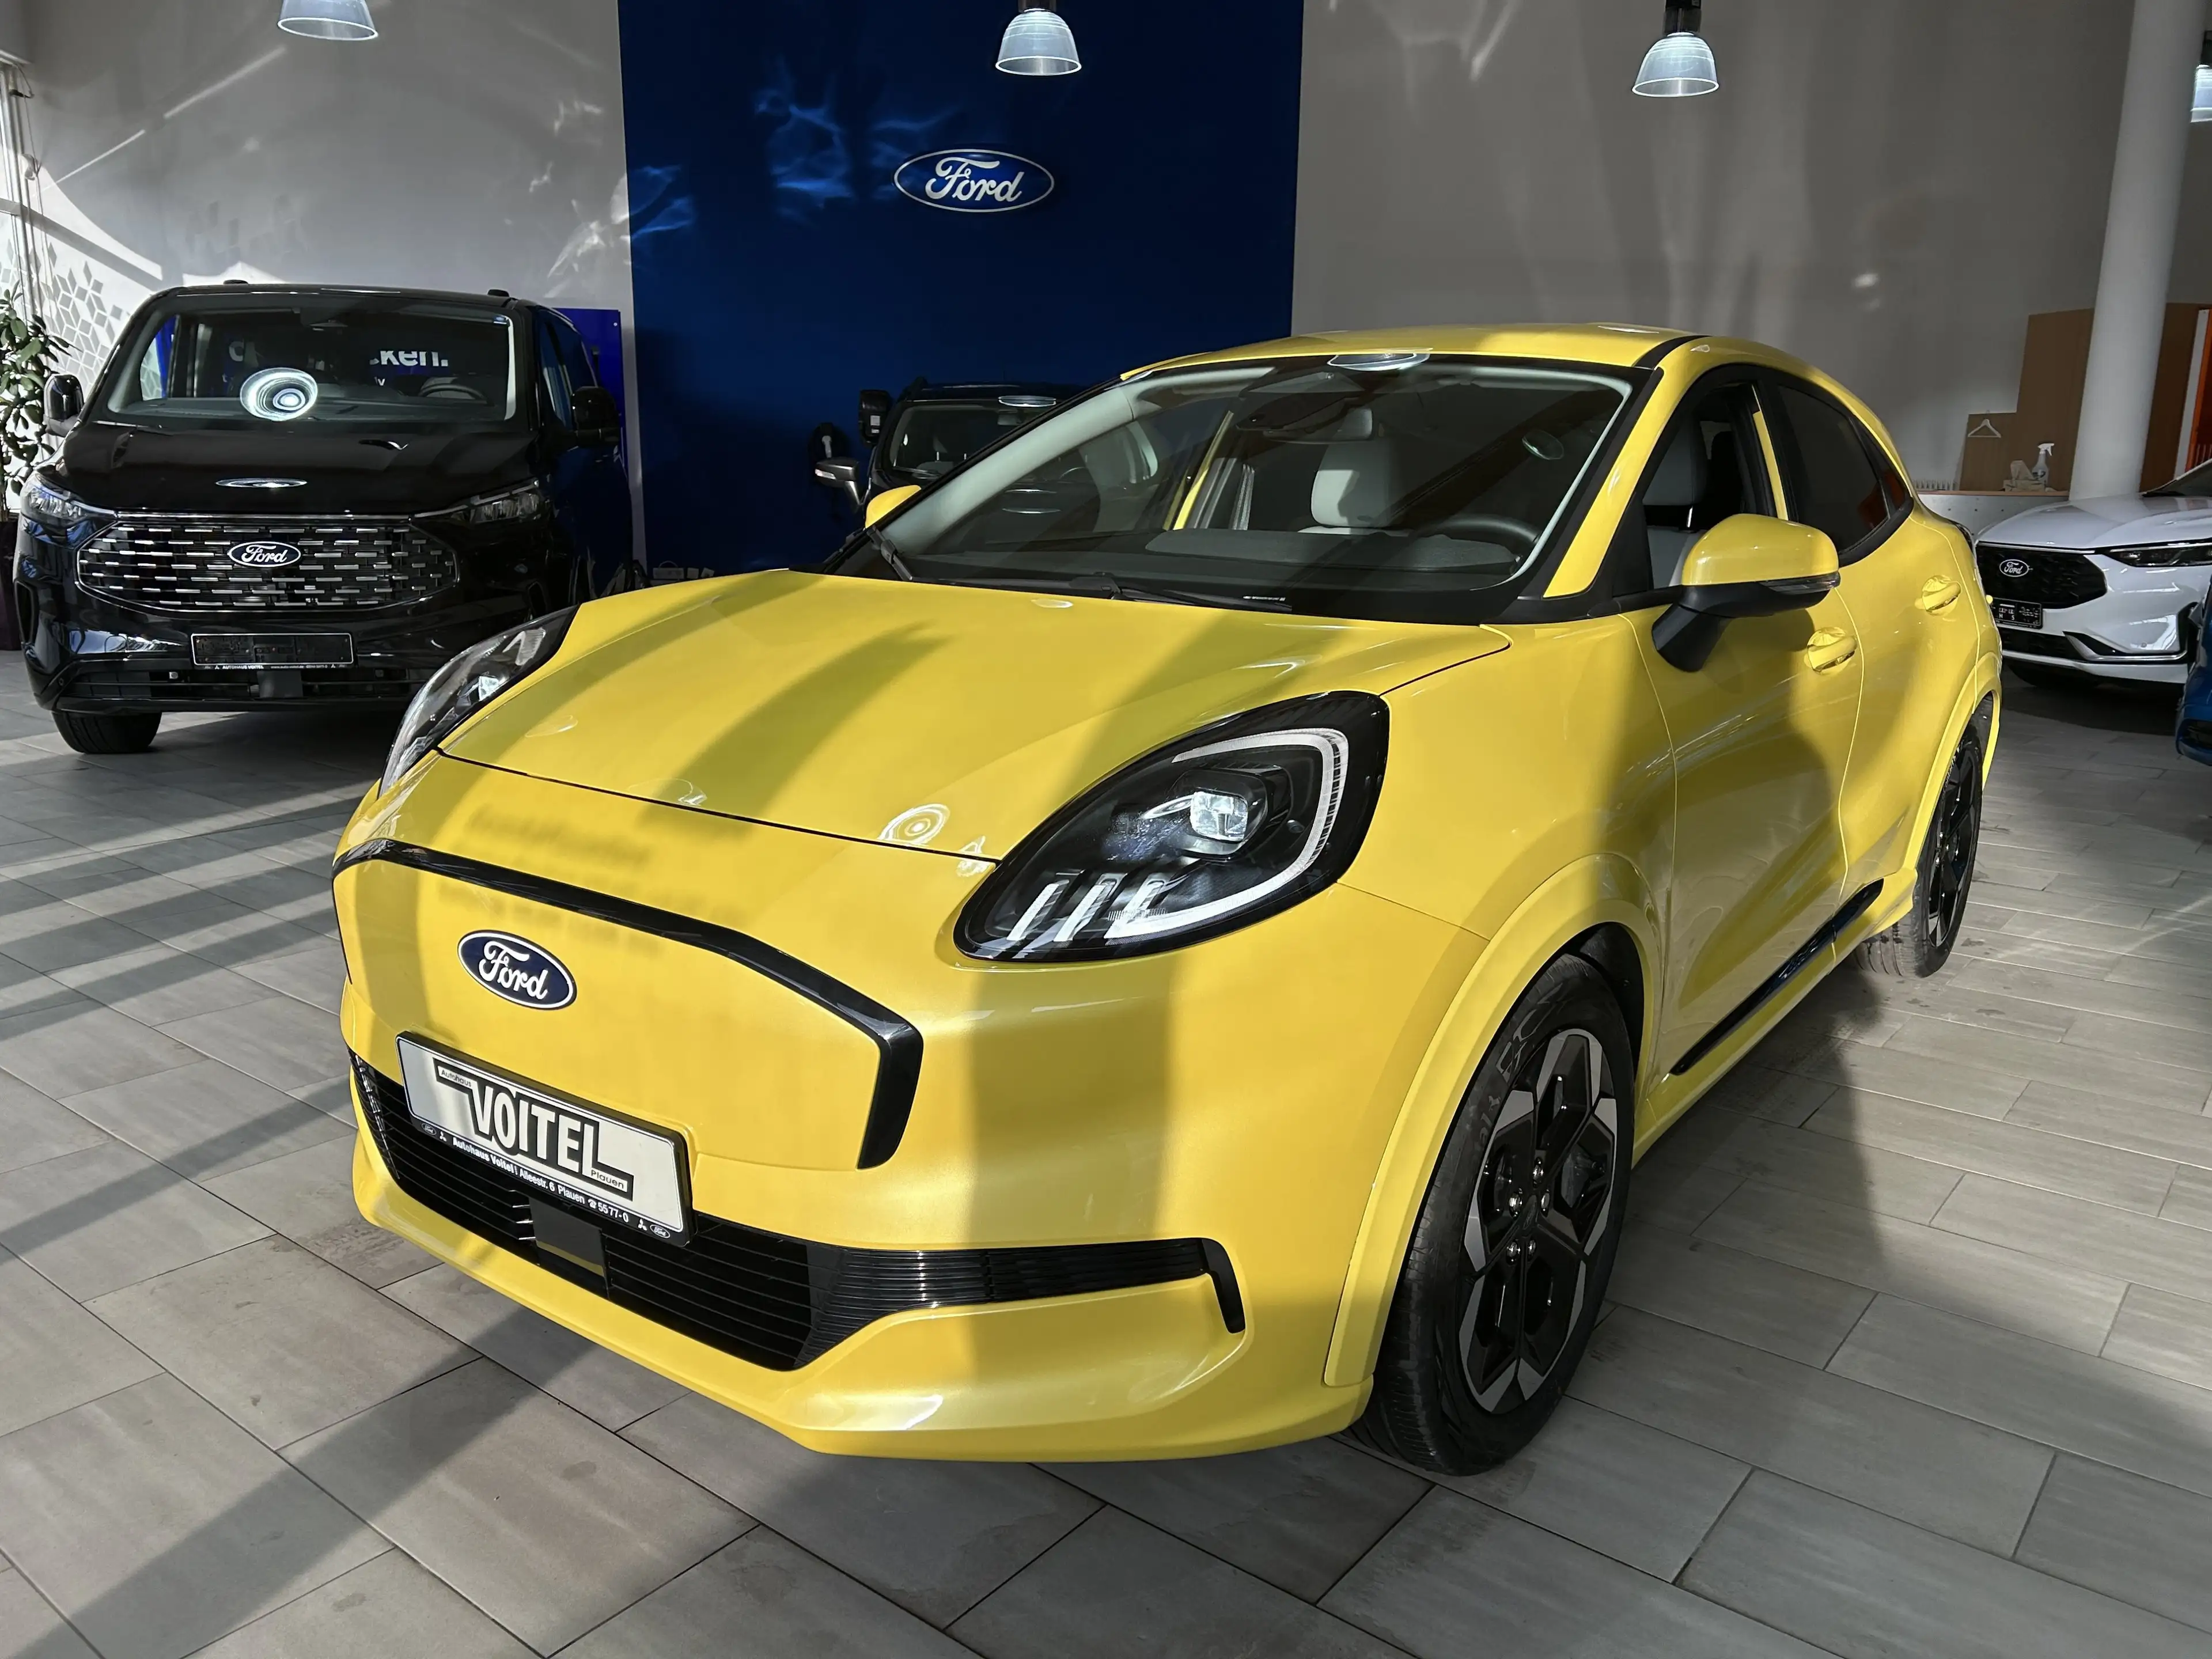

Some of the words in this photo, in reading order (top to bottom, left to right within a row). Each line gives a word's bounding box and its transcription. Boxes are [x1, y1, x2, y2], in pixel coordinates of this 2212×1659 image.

[925, 157, 1025, 202] Ford
[241, 544, 288, 562] Ford
[2004, 562, 2023, 574] Ford
[479, 941, 548, 999] Ford
[441, 1069, 472, 1088] Autohaus
[472, 1082, 598, 1177] VOITEL
[453, 1137, 490, 1162] Autohaus
[520, 1168, 548, 1189] Alleestr.
[549, 1181, 555, 1192] 6
[558, 1184, 585, 1205] Plauen
[591, 1169, 624, 1189] Plauen
